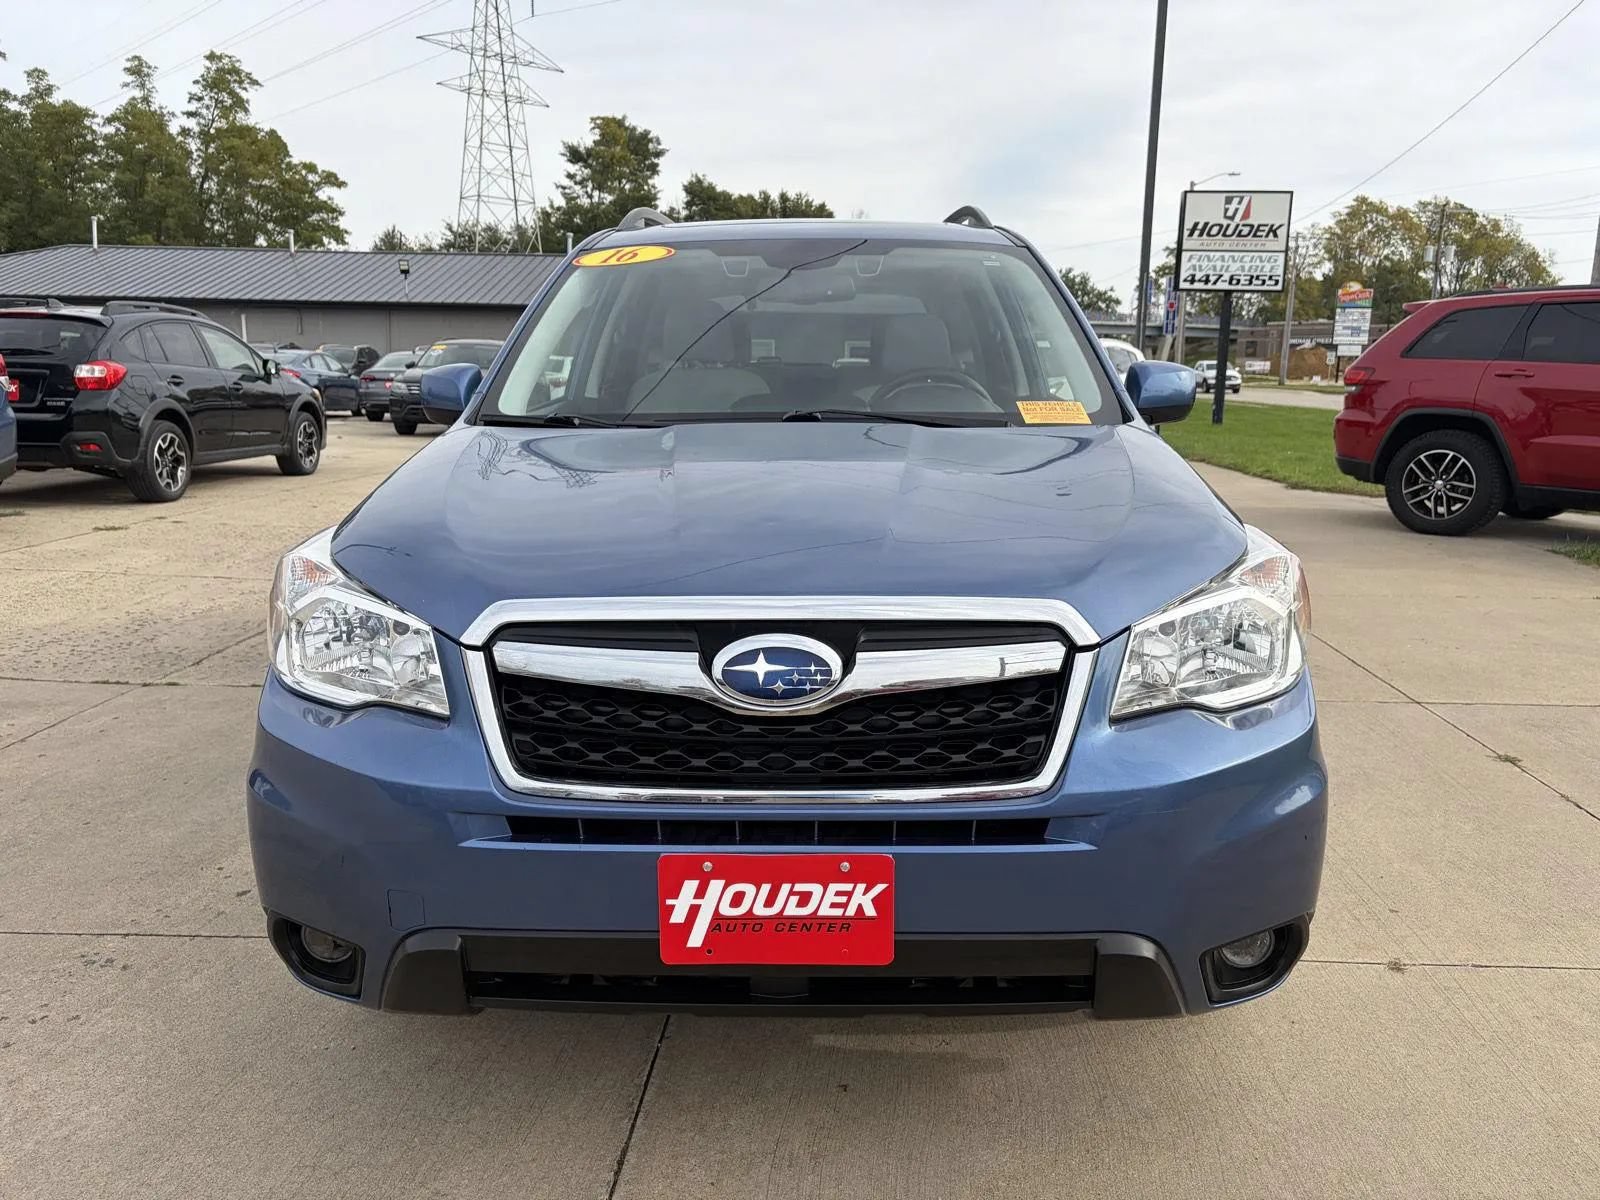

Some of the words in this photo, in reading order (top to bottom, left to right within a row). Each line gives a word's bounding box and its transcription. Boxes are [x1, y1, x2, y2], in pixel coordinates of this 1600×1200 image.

[1186, 221, 1285, 239] HOUDEK
[599, 246, 649, 264] 16
[1186, 254, 1280, 264] FINANCING
[1184, 263, 1281, 273] AVAILABLE
[1182, 273, 1281, 287] 447-6355
[666, 879, 890, 948] HOUDEK
[711, 922, 764, 933] AUTO
[774, 922, 852, 933] CENTER
